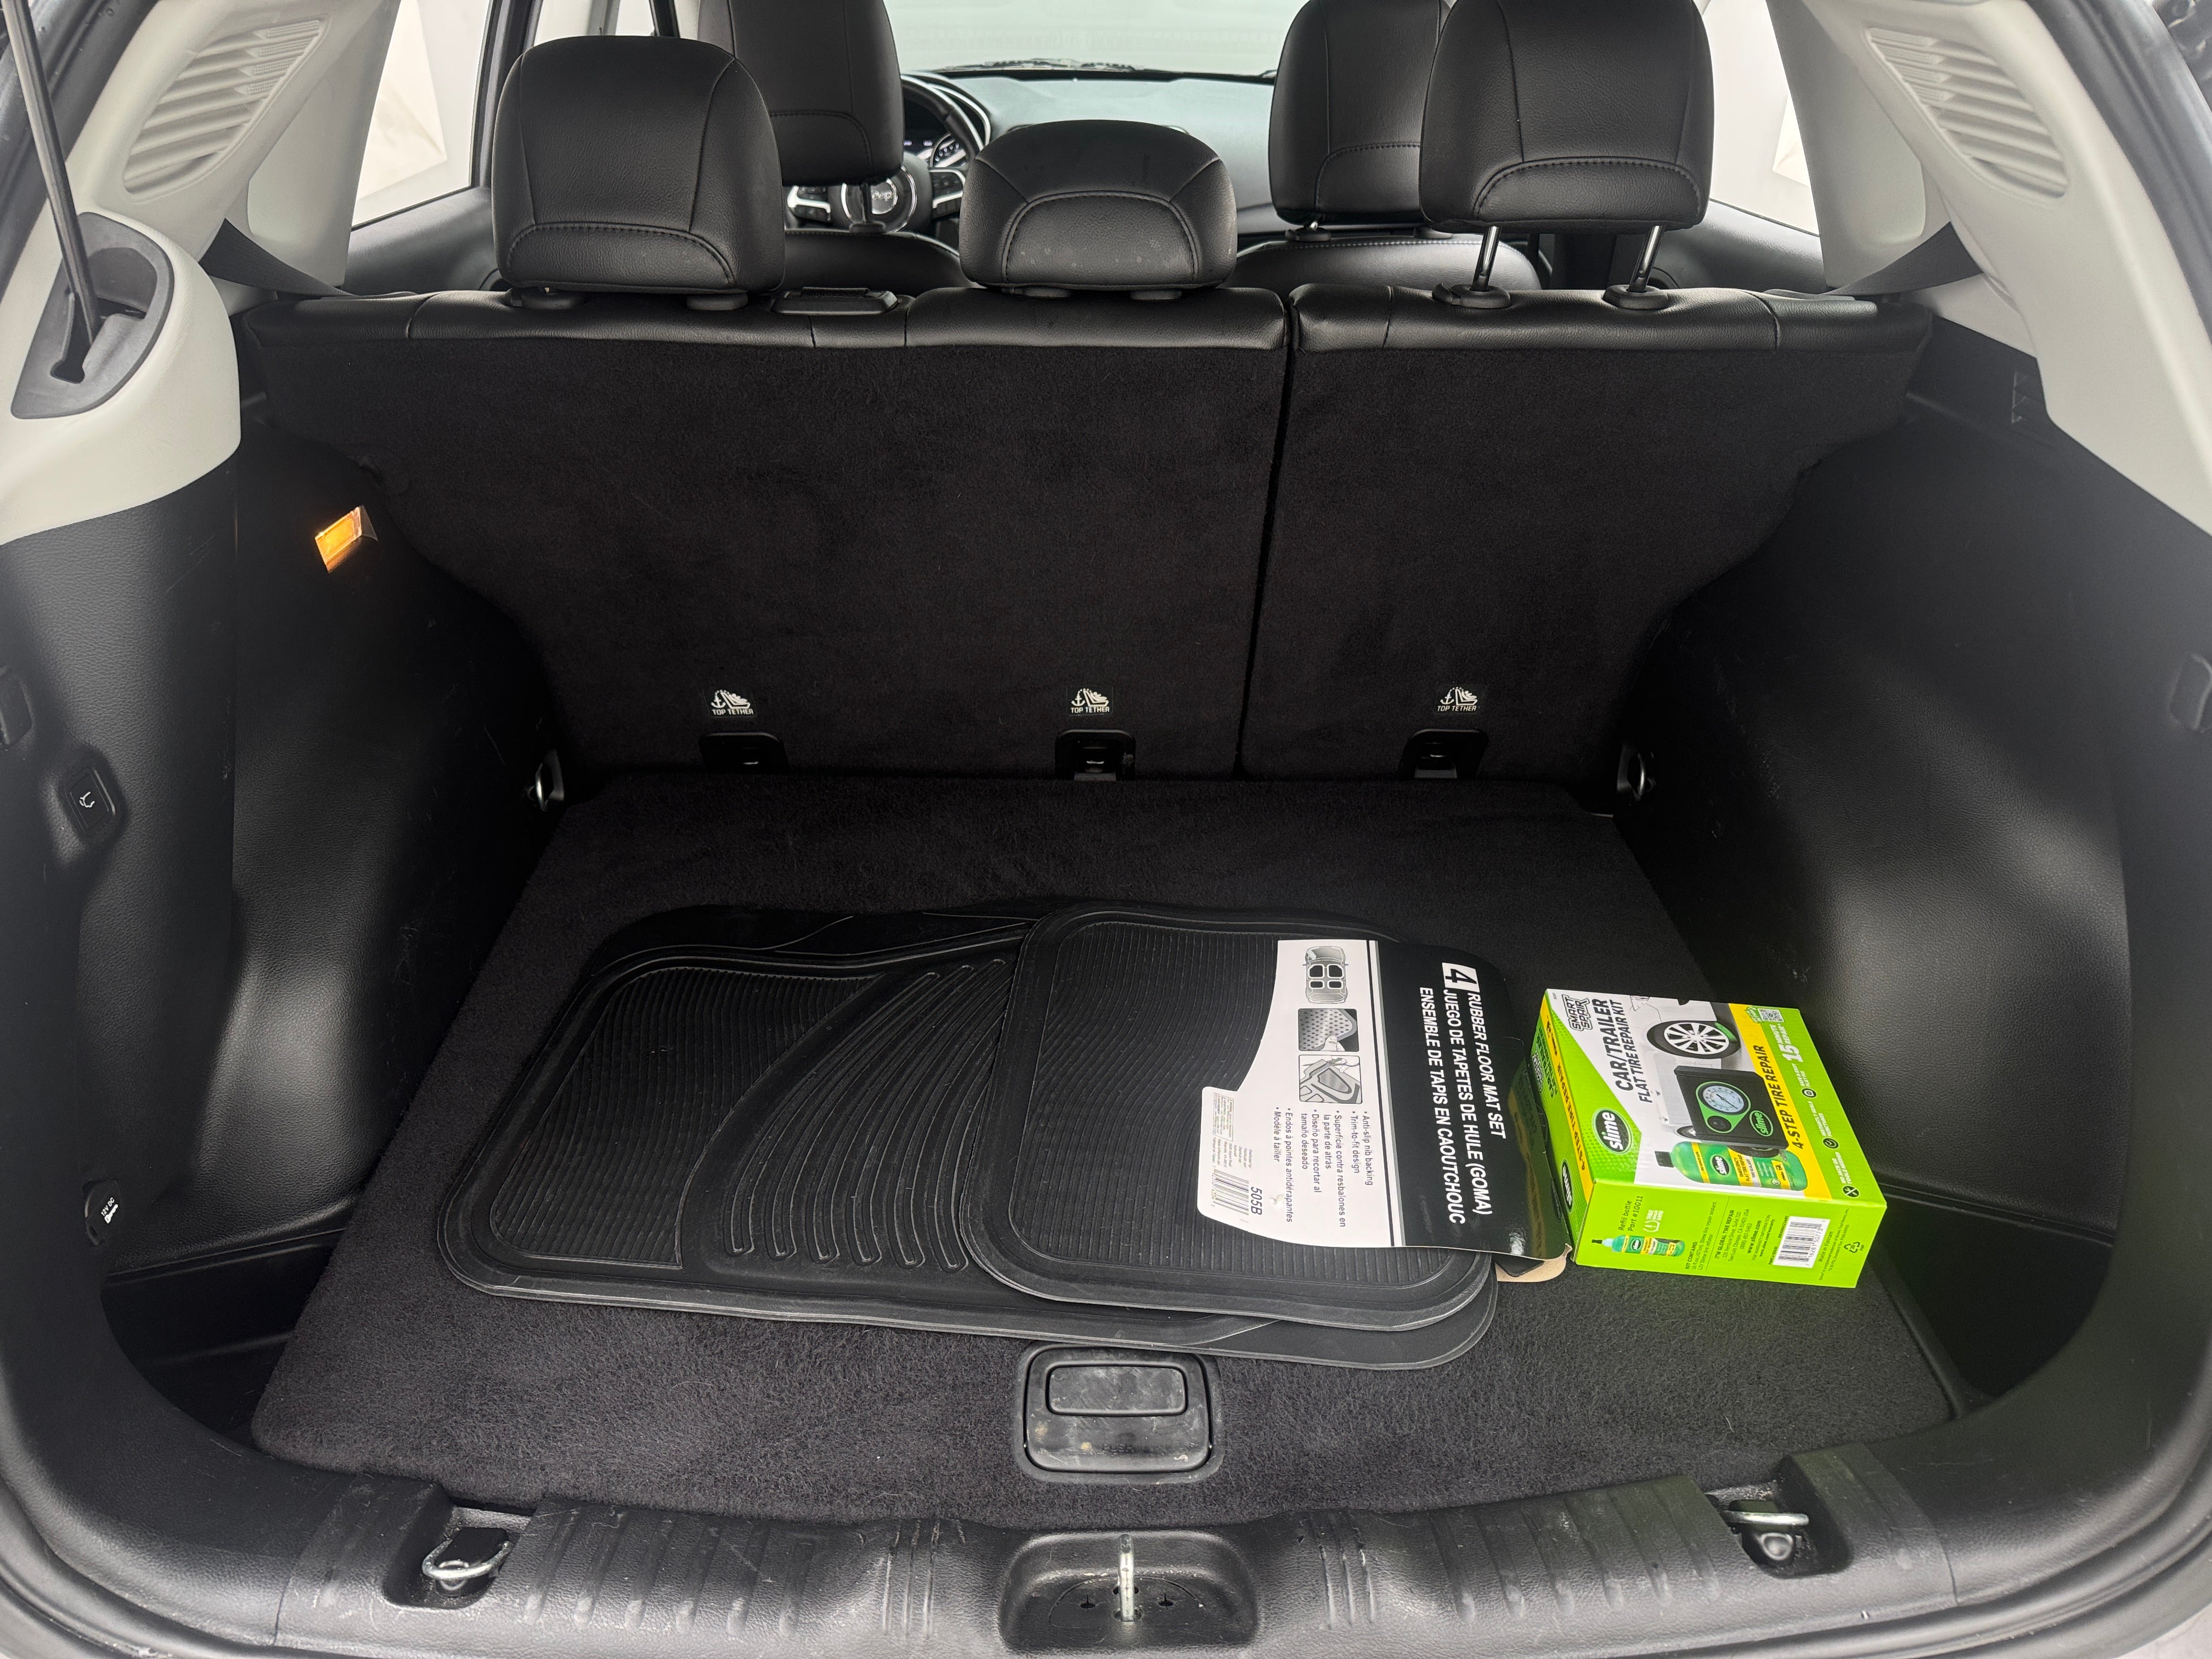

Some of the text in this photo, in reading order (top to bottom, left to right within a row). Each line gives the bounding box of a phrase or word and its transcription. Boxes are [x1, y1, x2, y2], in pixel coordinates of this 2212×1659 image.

[1443, 968, 1477, 985] 4
[1564, 996, 1582, 1029] SMART
[1574, 1000, 1594, 1029] SPAIR
[1590, 998, 1636, 1091] CAR/TRAILER
[1769, 1024, 1784, 1044] MINUTE
[1609, 999, 1653, 1103] FLAT TIRE REPAIR KIT
[1777, 1043, 1804, 1062] 15
[1466, 992, 1506, 1138] RUBBER FLOOR MAT SET
[1536, 1032, 1554, 1100] CAR/TRAILER
[1419, 987, 1465, 1224] ENSEMBLE DE TAPIS EN CAOUTCHOUC
[1443, 989, 1492, 1215] JUEGO DE TAPETES DE HULE (GOMA)
[1752, 1045, 1805, 1149] 4-STEP TIRE REPAIR
[1311, 1114, 1319, 1137] Diseño
[1556, 1059, 1585, 1175] 4-STEP TIRE REPAIR
[1752, 1111, 1769, 1135] slime
[1322, 1122, 1331, 1139] parte
[1333, 1115, 1343, 1149] Superficie
[1601, 1111, 1624, 1150] slime
[1284, 1141, 1293, 1166] pointes
[1301, 1139, 1310, 1169] deseado
[1310, 1138, 1319, 1153] para
[1324, 1141, 1331, 1149] de
[1350, 1115, 1361, 1173] Trim-to-fit design
[1361, 1115, 1374, 1186] Anti-slip nib backing
[1713, 1156, 1726, 1175] slime
[1841, 1169, 1853, 1184] TOOLS
[1284, 1168, 1294, 1222] antidérapantes
[1337, 1175, 1346, 1215] resbalones
[1561, 1163, 1573, 1206] slime
[101, 1205, 109, 1216] 12V
[1250, 1187, 1262, 1215] 505B
[1621, 1200, 1632, 1216] bottle
[1626, 1195, 1644, 1231] Part #10011
[1339, 1217, 1346, 1227] en
[1617, 1216, 1628, 1231] Refill
[1645, 1209, 1654, 1220] TIRE
[1725, 1209, 1735, 1224] REPAIR
[1722, 1224, 1730, 1233] TIRE
[1745, 1220, 1762, 1254] www.slime.com
[1813, 1228, 1824, 1242] 50773
[1686, 1240, 1698, 1262] CONTAINS:
[1717, 1234, 1727, 1250] GLOBAL
[1817, 1251, 1826, 1262] Made
